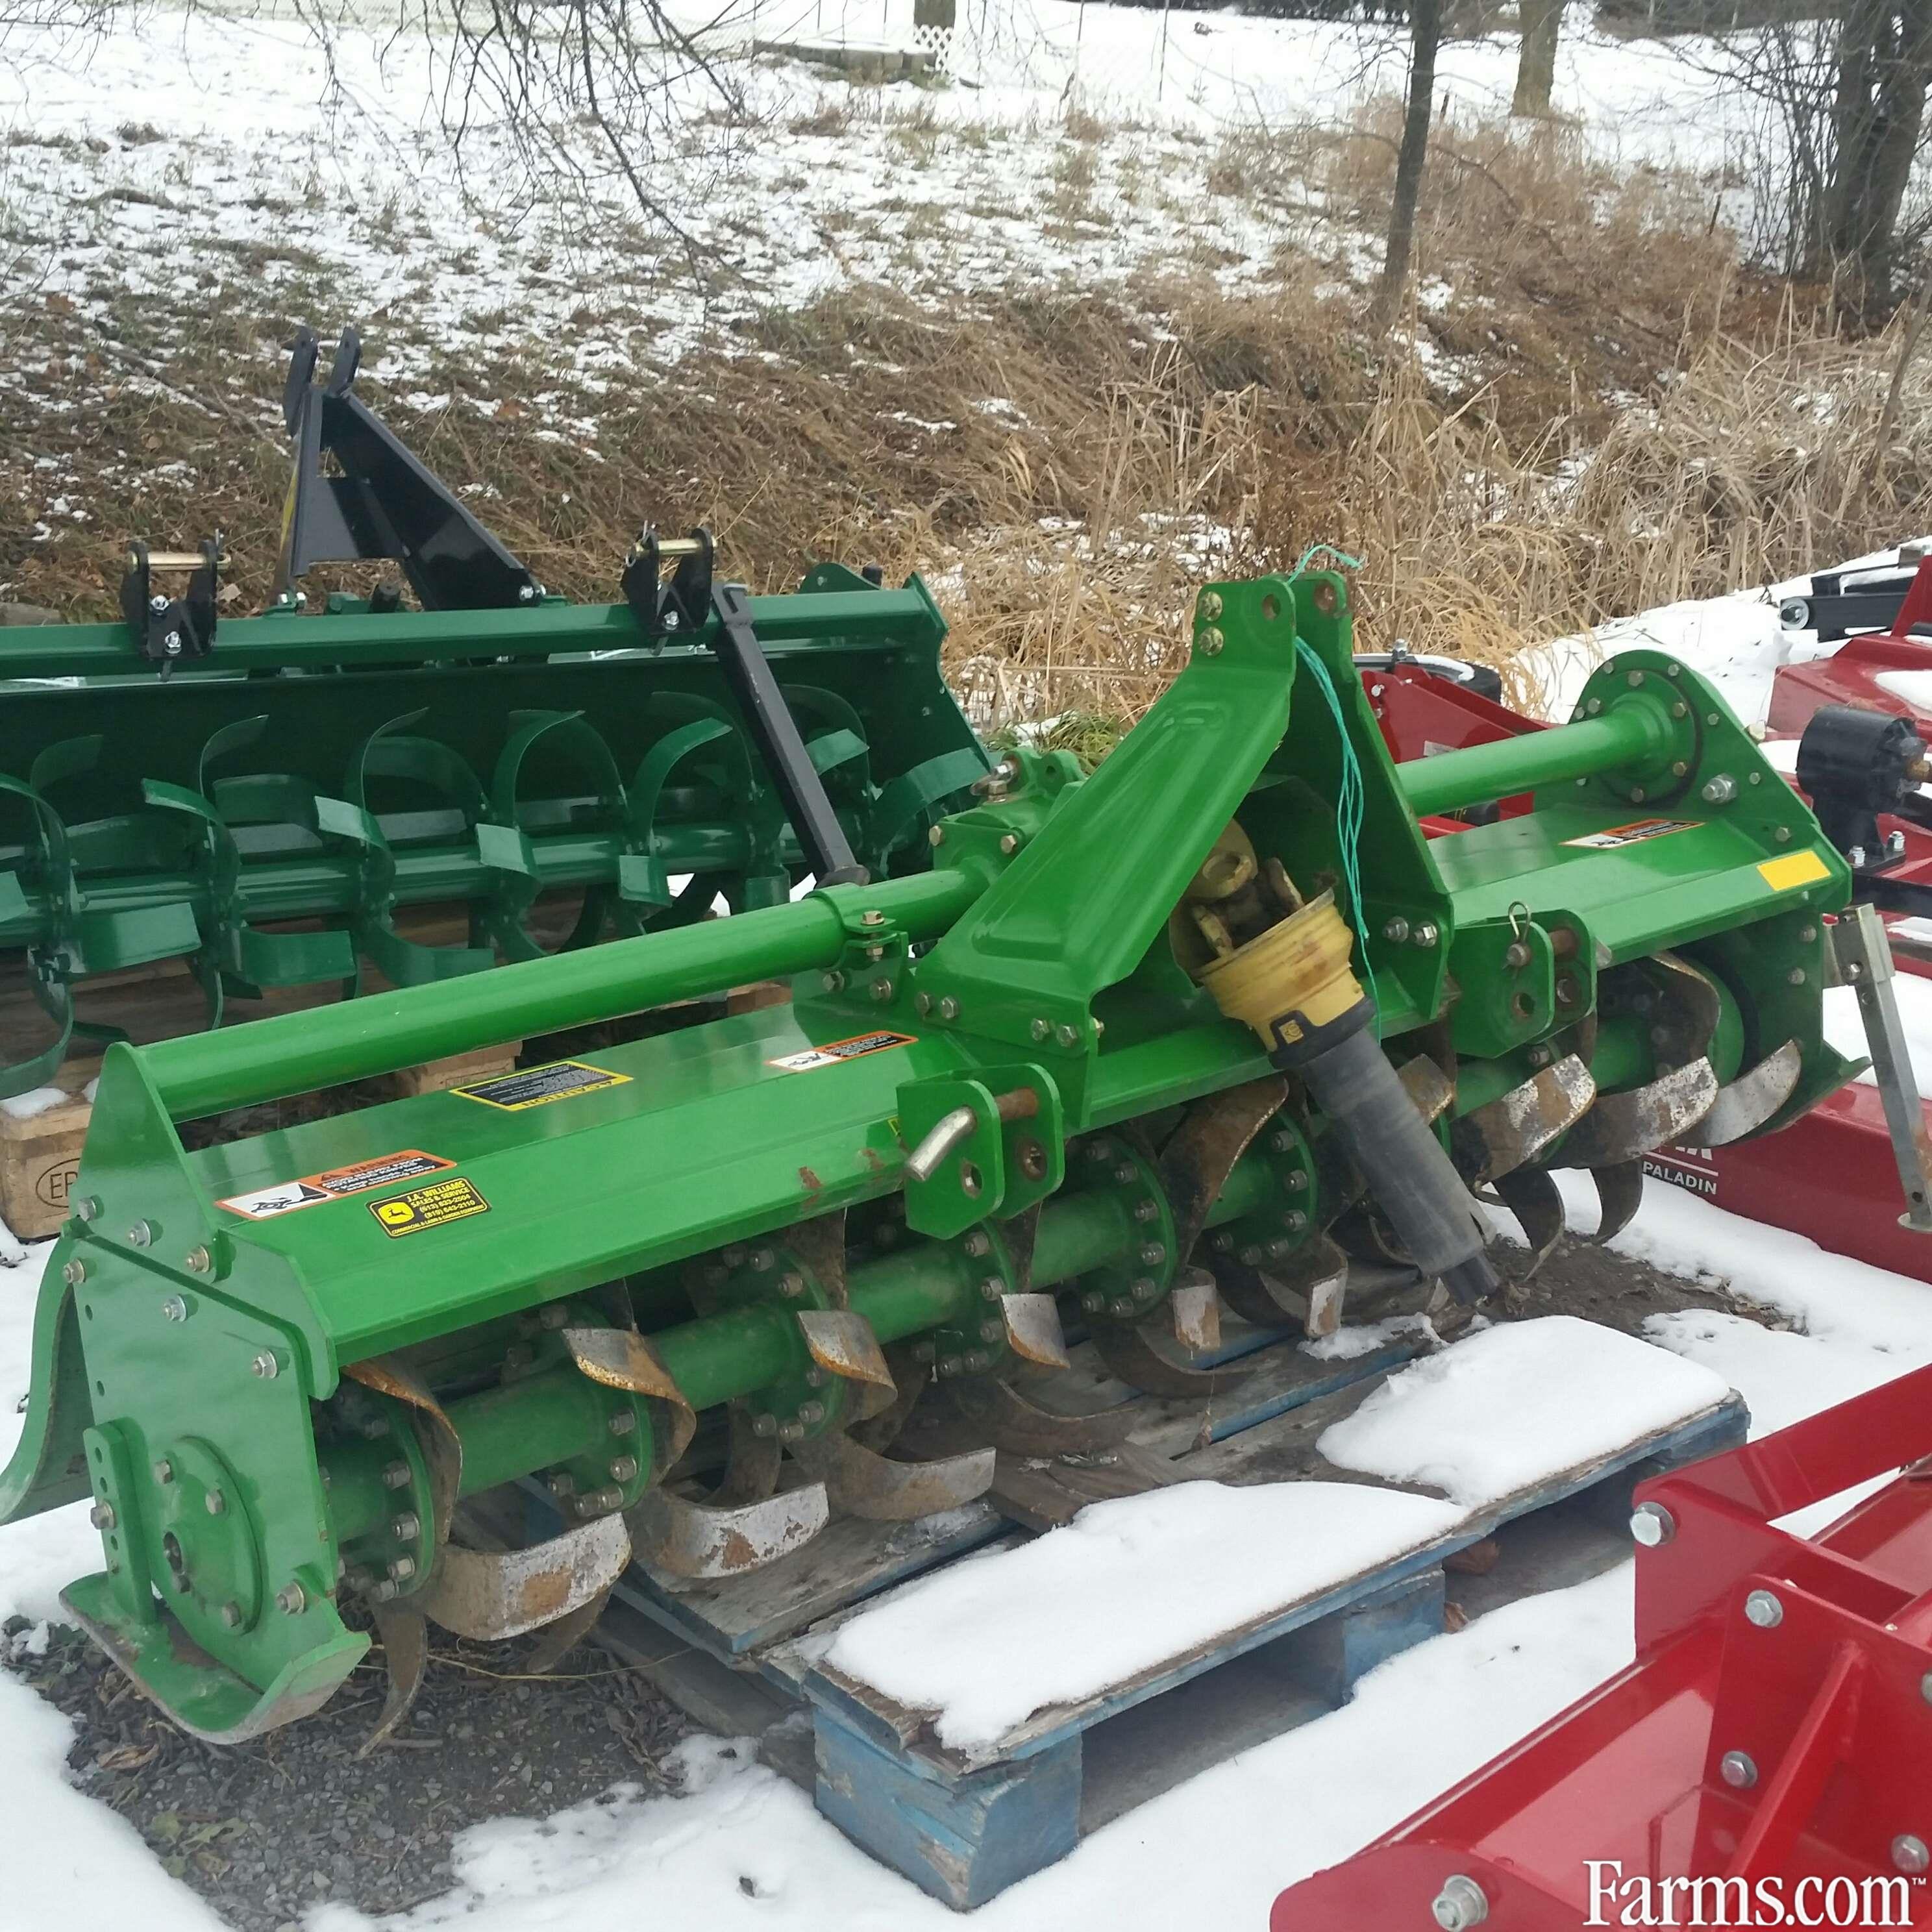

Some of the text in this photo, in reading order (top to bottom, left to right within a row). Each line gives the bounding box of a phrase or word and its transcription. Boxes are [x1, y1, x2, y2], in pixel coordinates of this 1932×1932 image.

[1643, 1161, 1717, 1195] PALADIN
[407, 1180, 465, 1202] J.A. WILLIAMS
[410, 1197, 434, 1208] SALES
[441, 1187, 471, 1200] SERVICE
